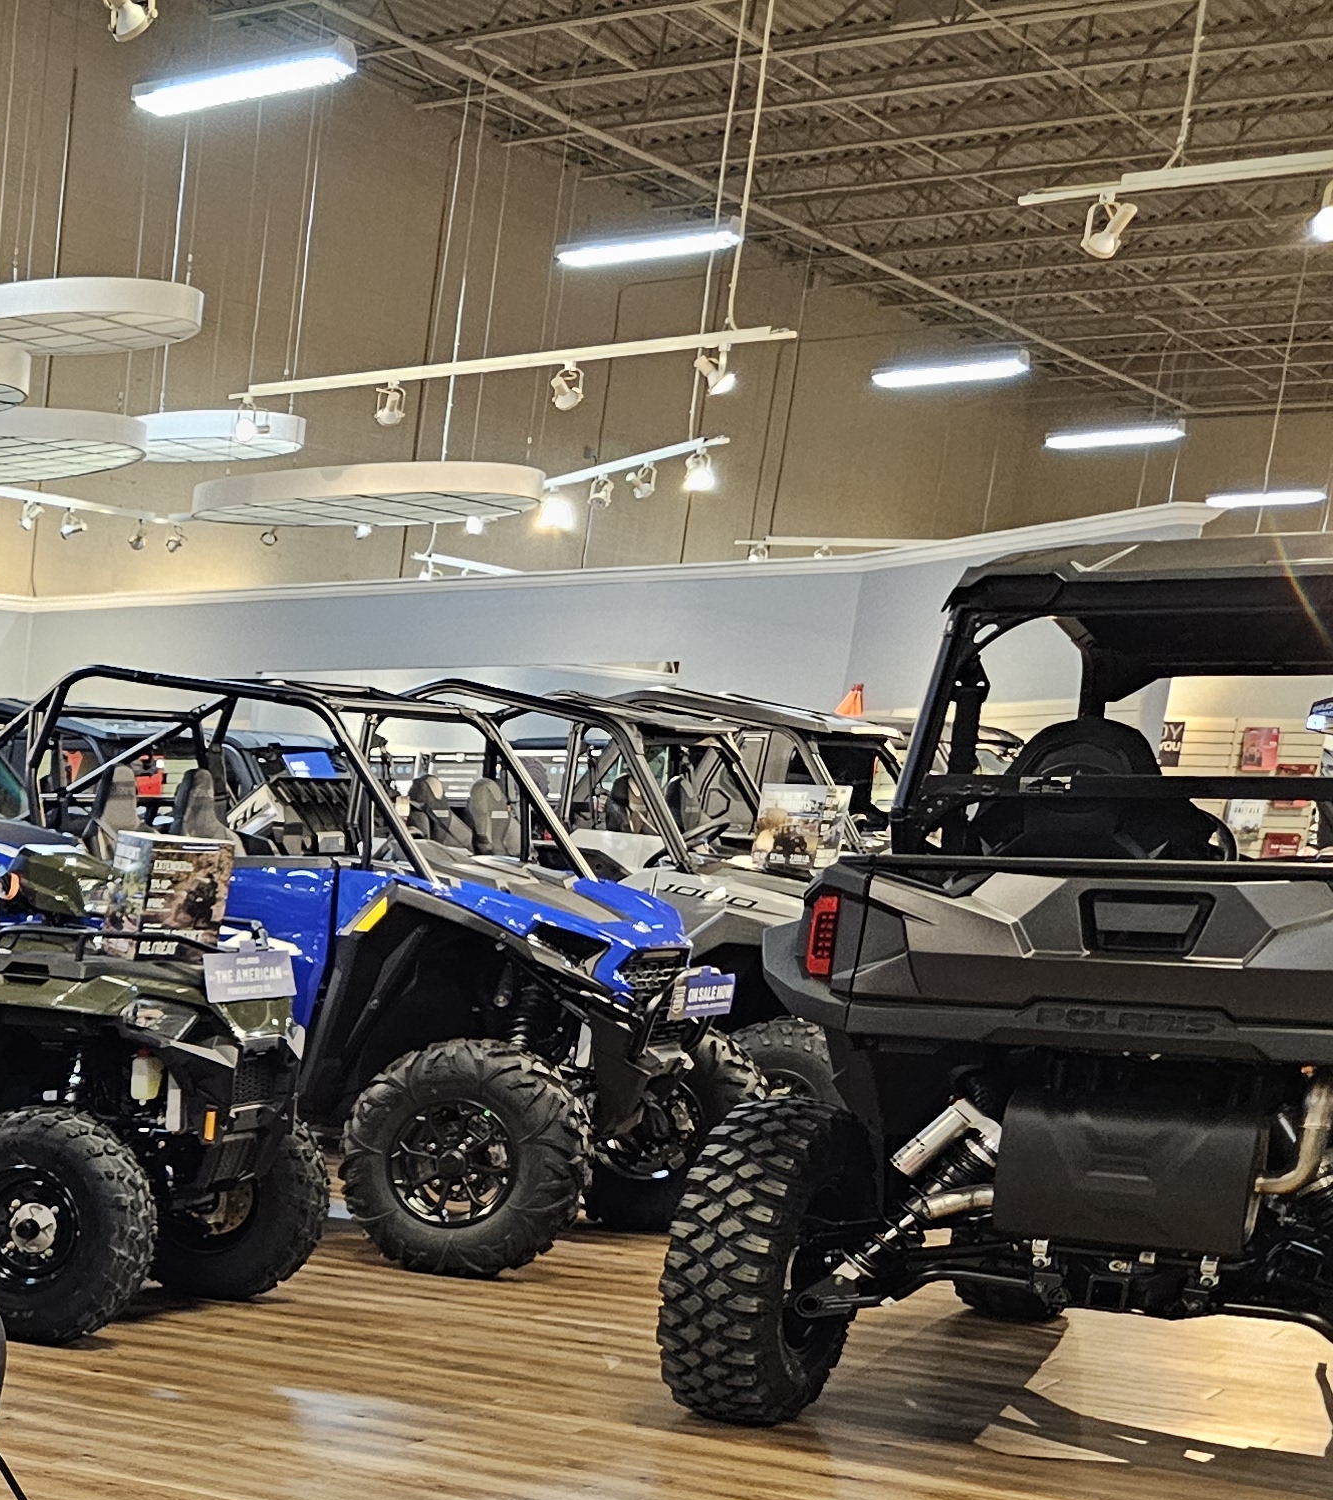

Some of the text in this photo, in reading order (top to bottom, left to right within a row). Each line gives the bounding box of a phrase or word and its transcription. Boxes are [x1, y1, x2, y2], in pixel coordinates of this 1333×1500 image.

[215, 966, 282, 984] THE AMERICAN
[688, 988, 699, 1003] ON
[698, 985, 717, 1002] SALE
[1036, 1006, 1216, 1034] POLARIS
